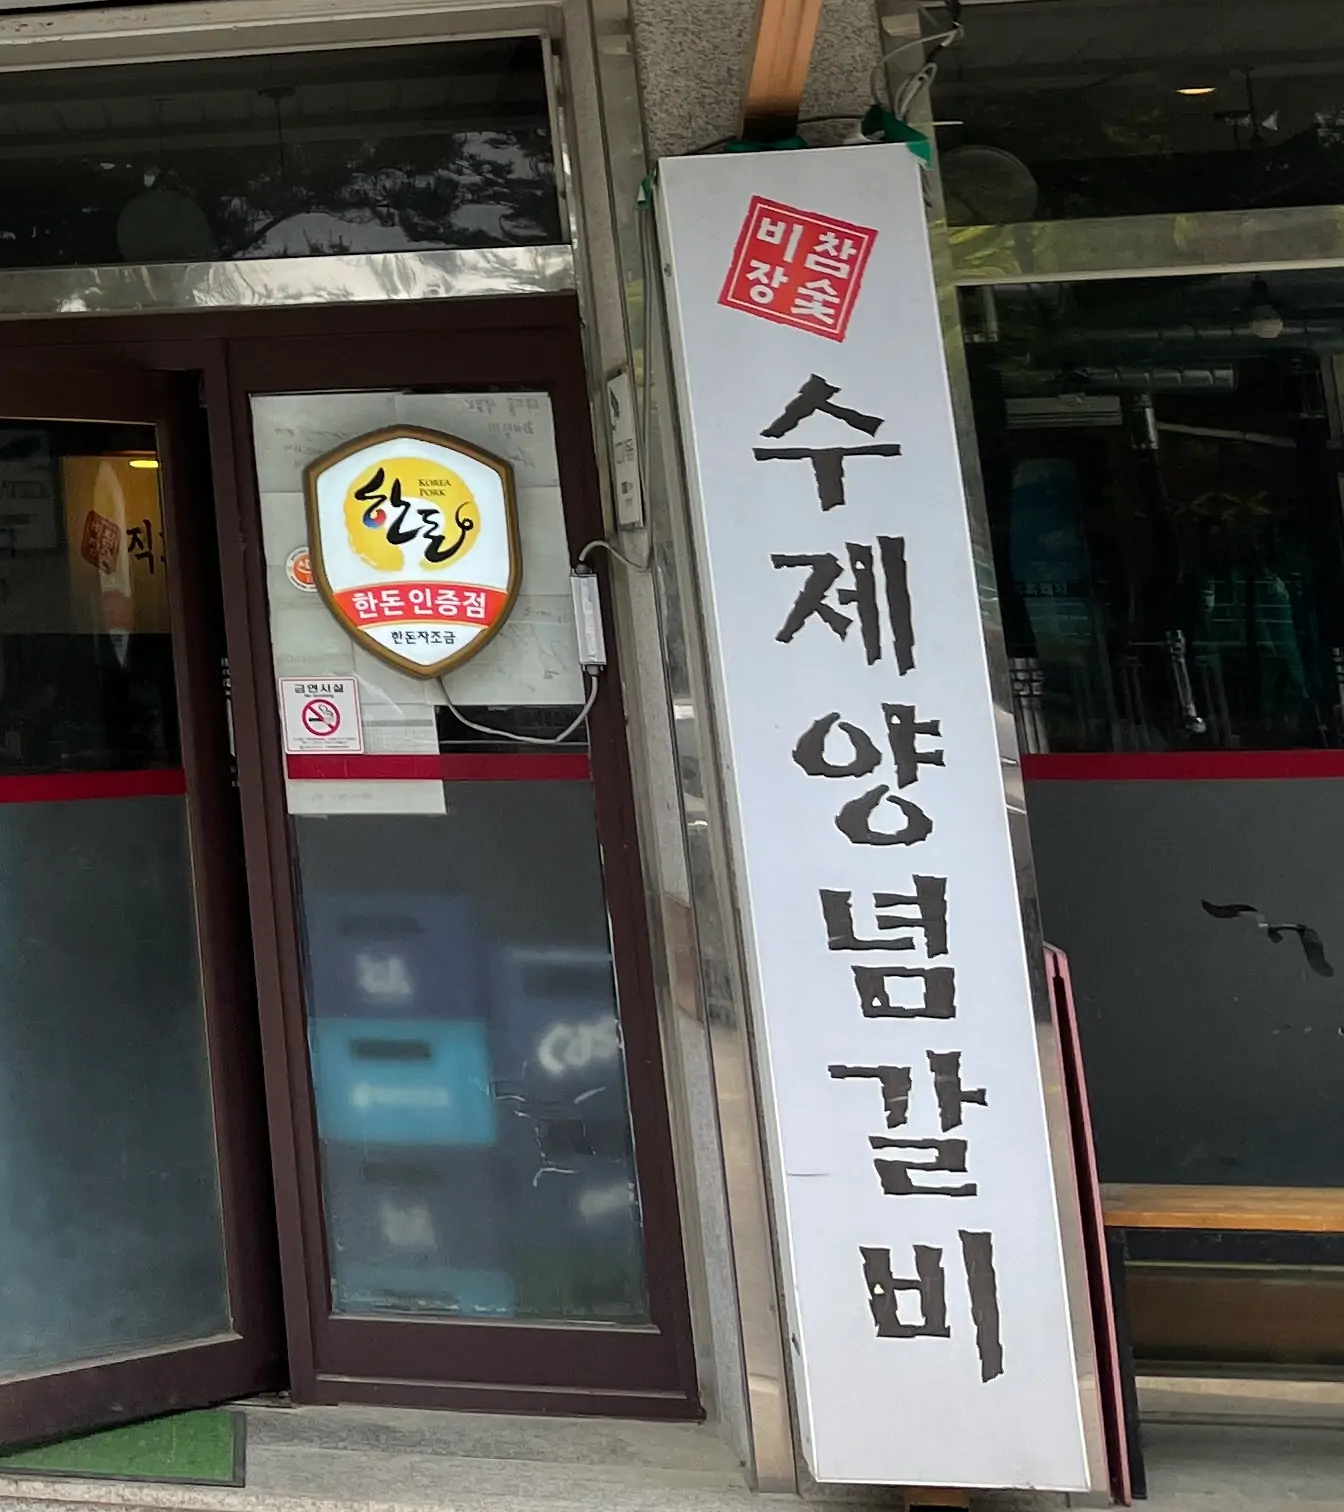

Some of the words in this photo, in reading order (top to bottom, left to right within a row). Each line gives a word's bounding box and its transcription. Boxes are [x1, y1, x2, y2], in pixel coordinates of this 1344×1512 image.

[418, 478, 452, 488] KOREA
[419, 488, 447, 497] PORK
[355, 467, 474, 563] 한돈
[352, 589, 406, 619] 한돈
[408, 588, 487, 619] 인증점
[391, 630, 457, 645] 한돈자조금
